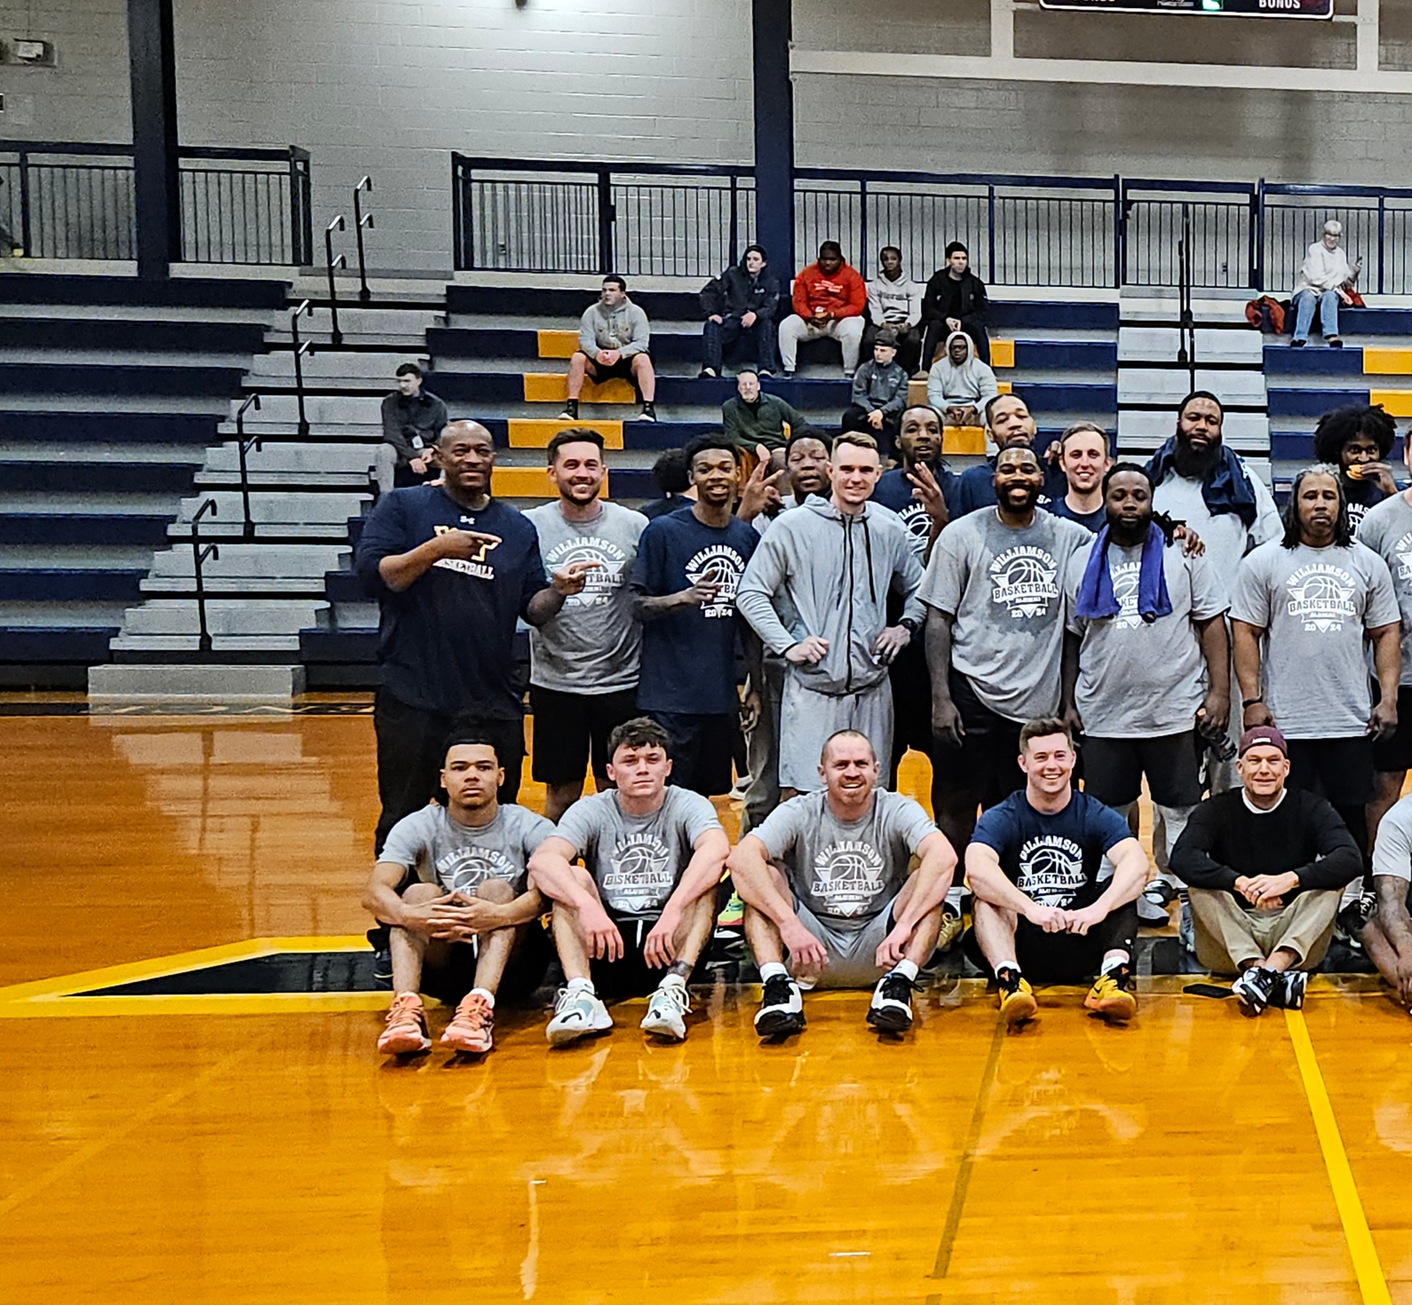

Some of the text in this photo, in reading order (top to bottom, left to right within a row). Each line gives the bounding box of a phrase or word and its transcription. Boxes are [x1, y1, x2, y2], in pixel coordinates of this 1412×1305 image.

[545, 536, 626, 562] WILLIAMSON
[685, 545, 746, 572] WILLIAMSON
[989, 546, 1058, 573] WILLIAMSON
[1286, 563, 1356, 588] WILLIAMSON
[994, 583, 1058, 600] BASKETBALL
[1011, 607, 1046, 618] 20 24
[1289, 600, 1355, 613] BASKETBALL
[1115, 621, 1127, 629] 20
[1304, 623, 1342, 632] 20 24
[436, 846, 515, 874] WILLIAMSON
[815, 840, 883, 867] WILLIAMSON
[813, 880, 884, 893] BASKETBALL
